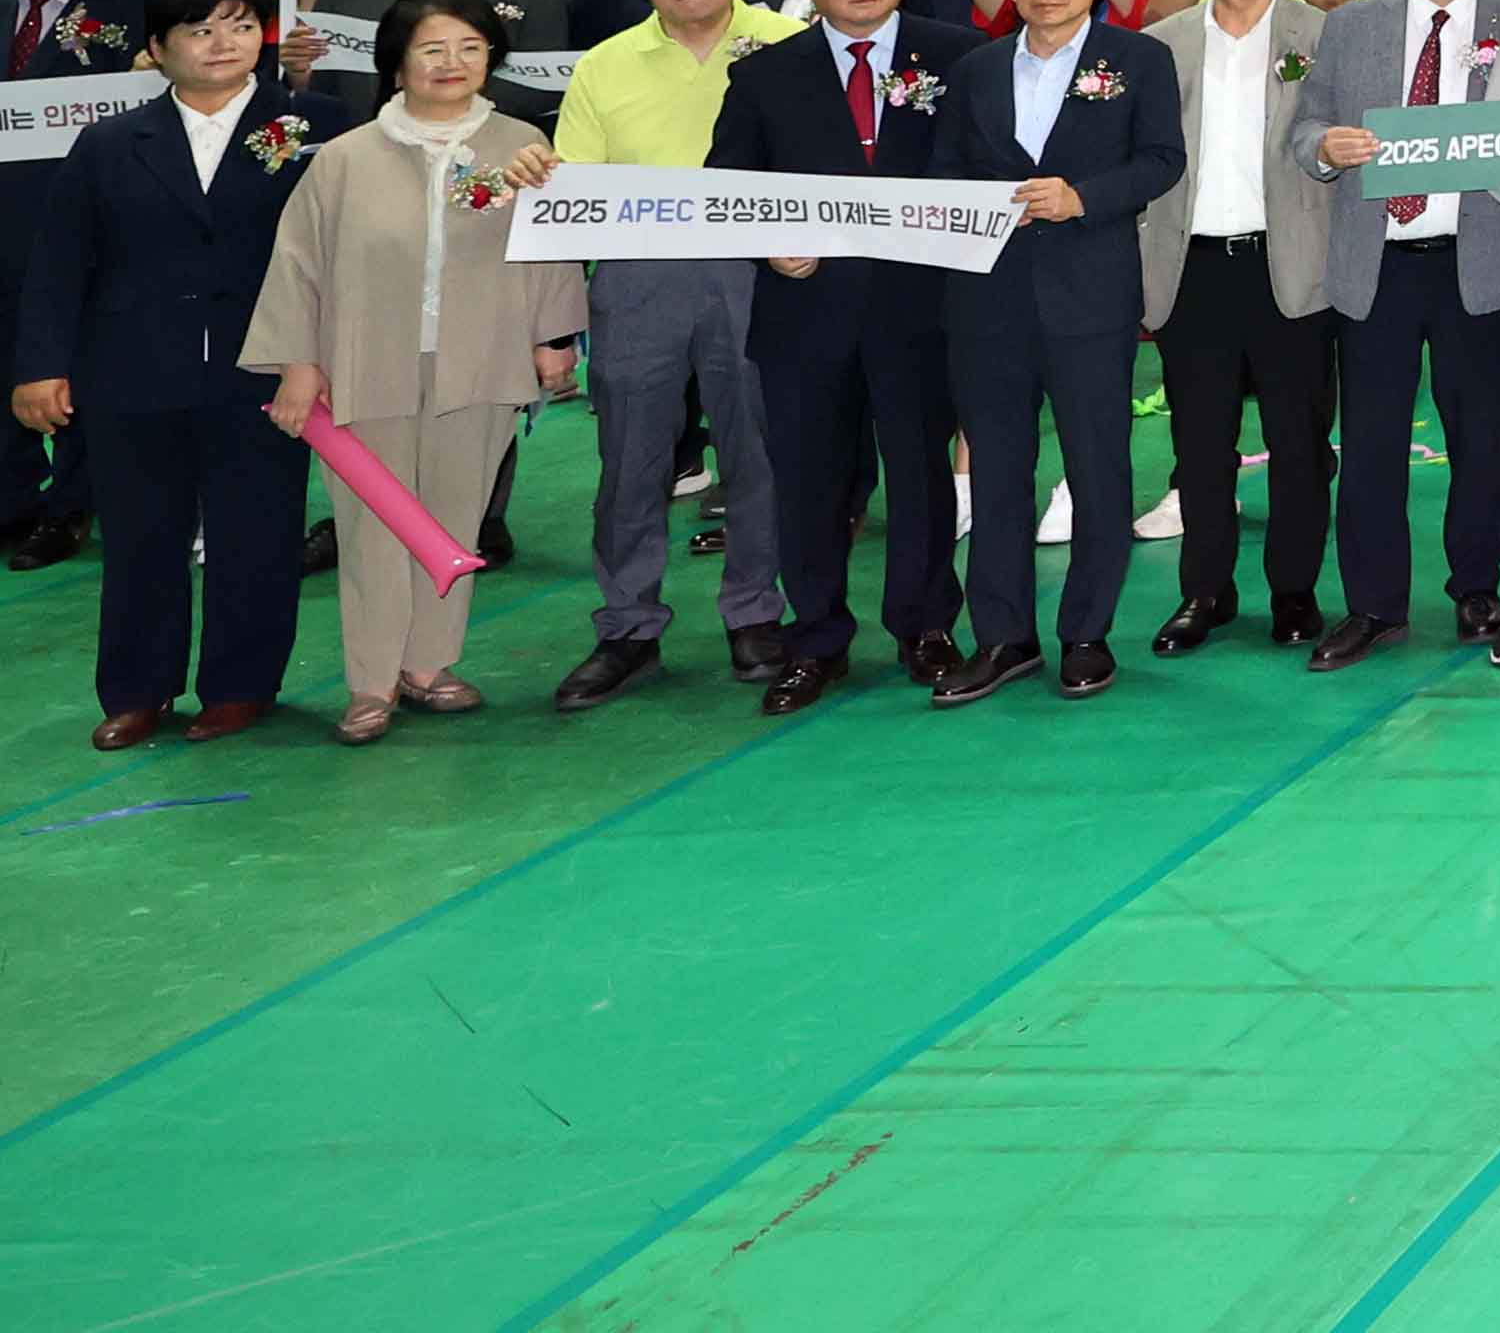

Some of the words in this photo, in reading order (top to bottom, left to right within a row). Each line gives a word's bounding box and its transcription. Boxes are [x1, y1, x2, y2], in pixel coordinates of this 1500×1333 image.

[1377, 140, 1440, 166] 2025
[532, 198, 608, 223] 2025
[616, 198, 695, 222] APEC
[704, 197, 809, 223] 정상회의
[817, 201, 892, 227] 이제는
